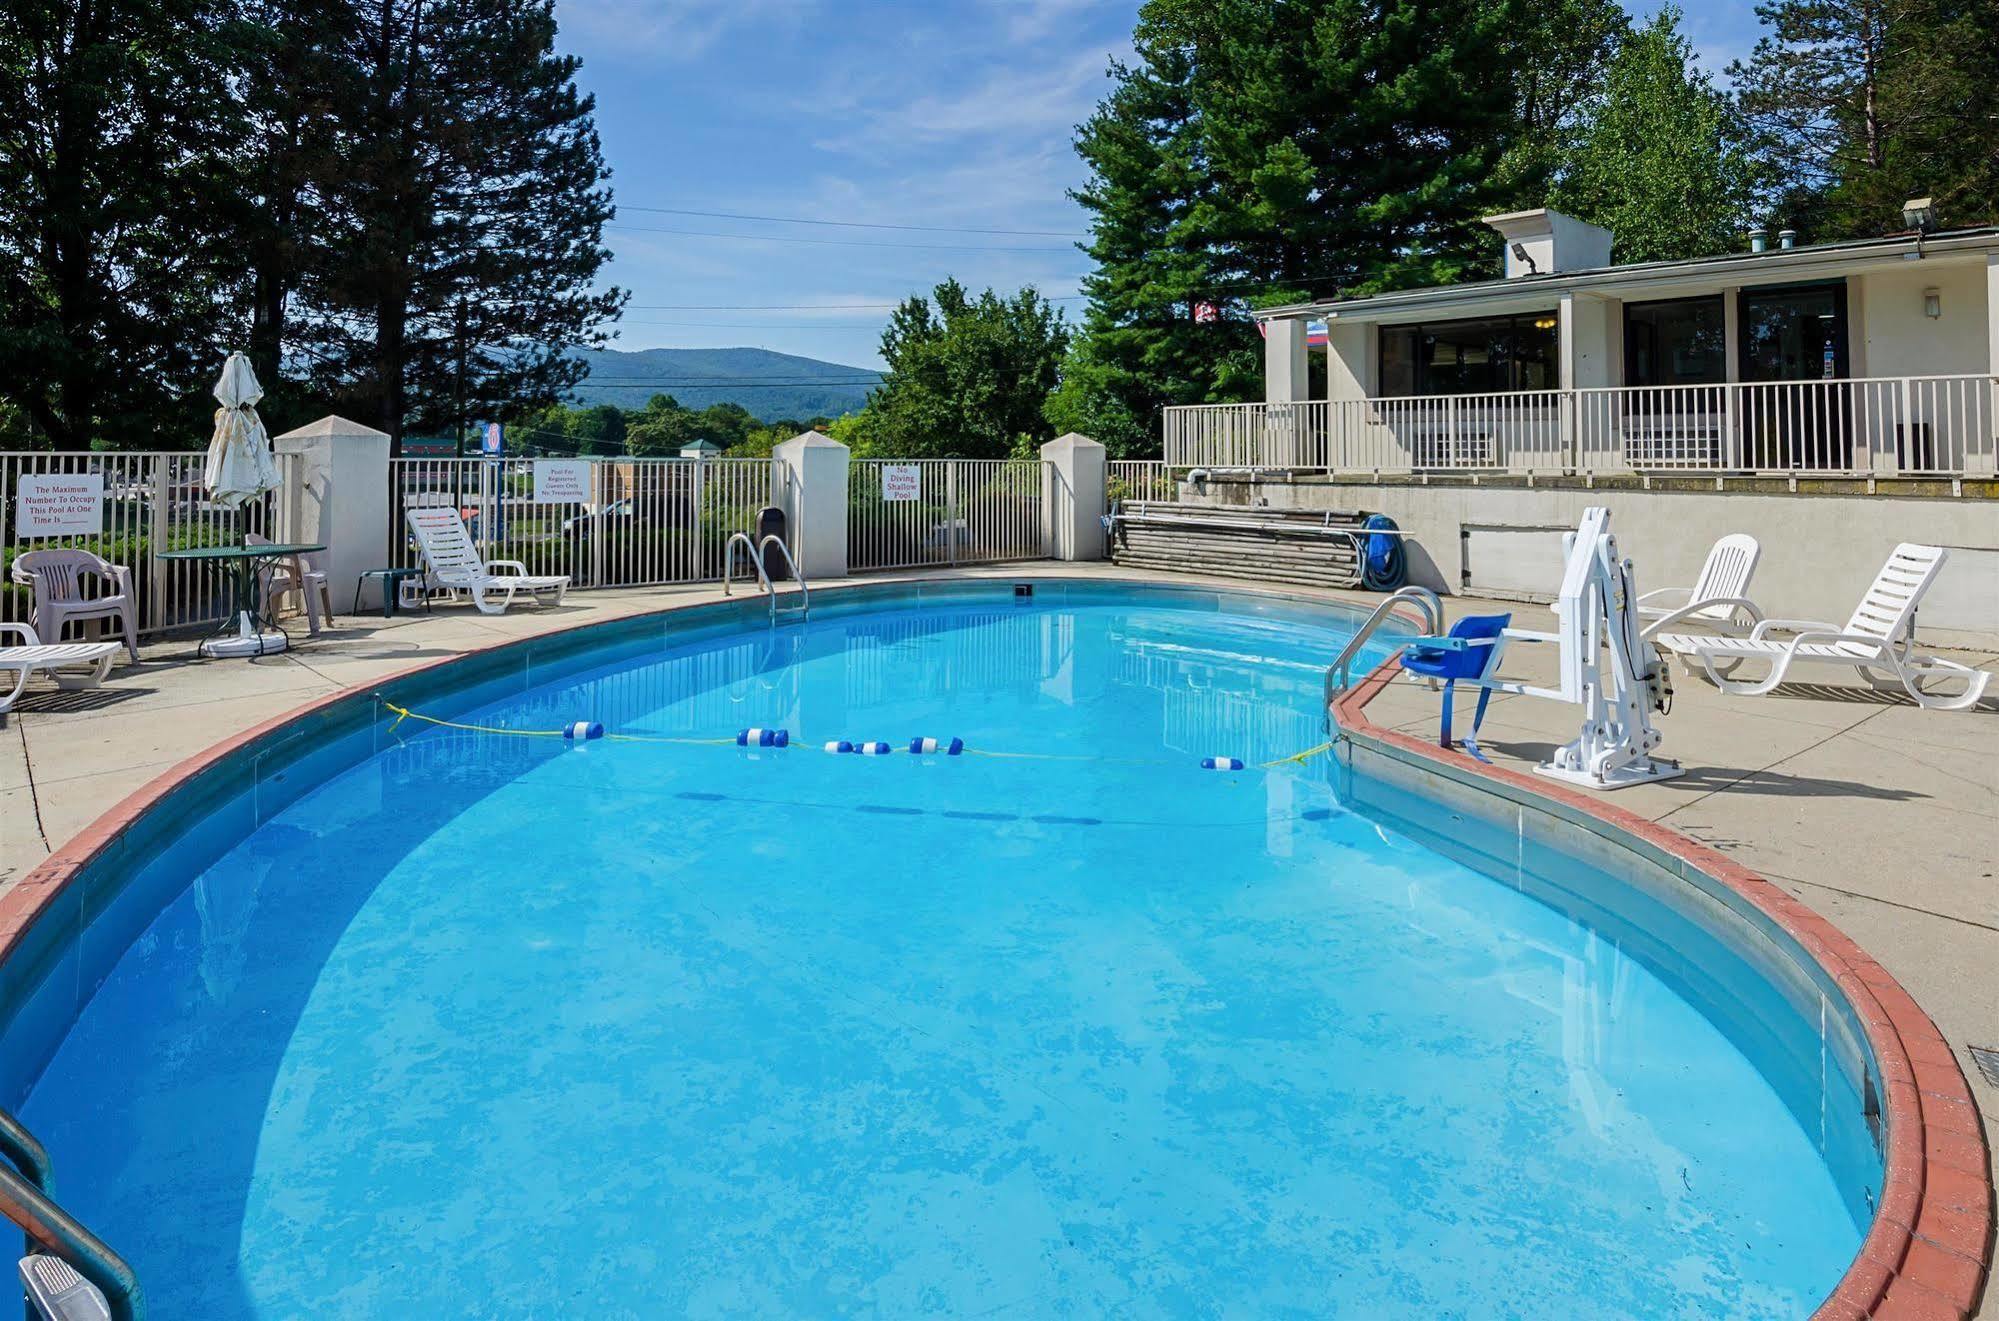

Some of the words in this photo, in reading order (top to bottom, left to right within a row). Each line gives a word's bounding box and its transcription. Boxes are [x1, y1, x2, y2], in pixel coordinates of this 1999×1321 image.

[890, 475, 915, 483] Diving
[35, 486, 50, 494] The
[52, 486, 88, 494] Maximum
[887, 483, 917, 491] Shallow
[25, 496, 57, 504] Number
[69, 496, 96, 504] Occupy
[29, 507, 46, 515] This
[48, 506, 65, 514] Pool
[77, 505, 92, 513] One
[32, 516, 51, 524] Time
